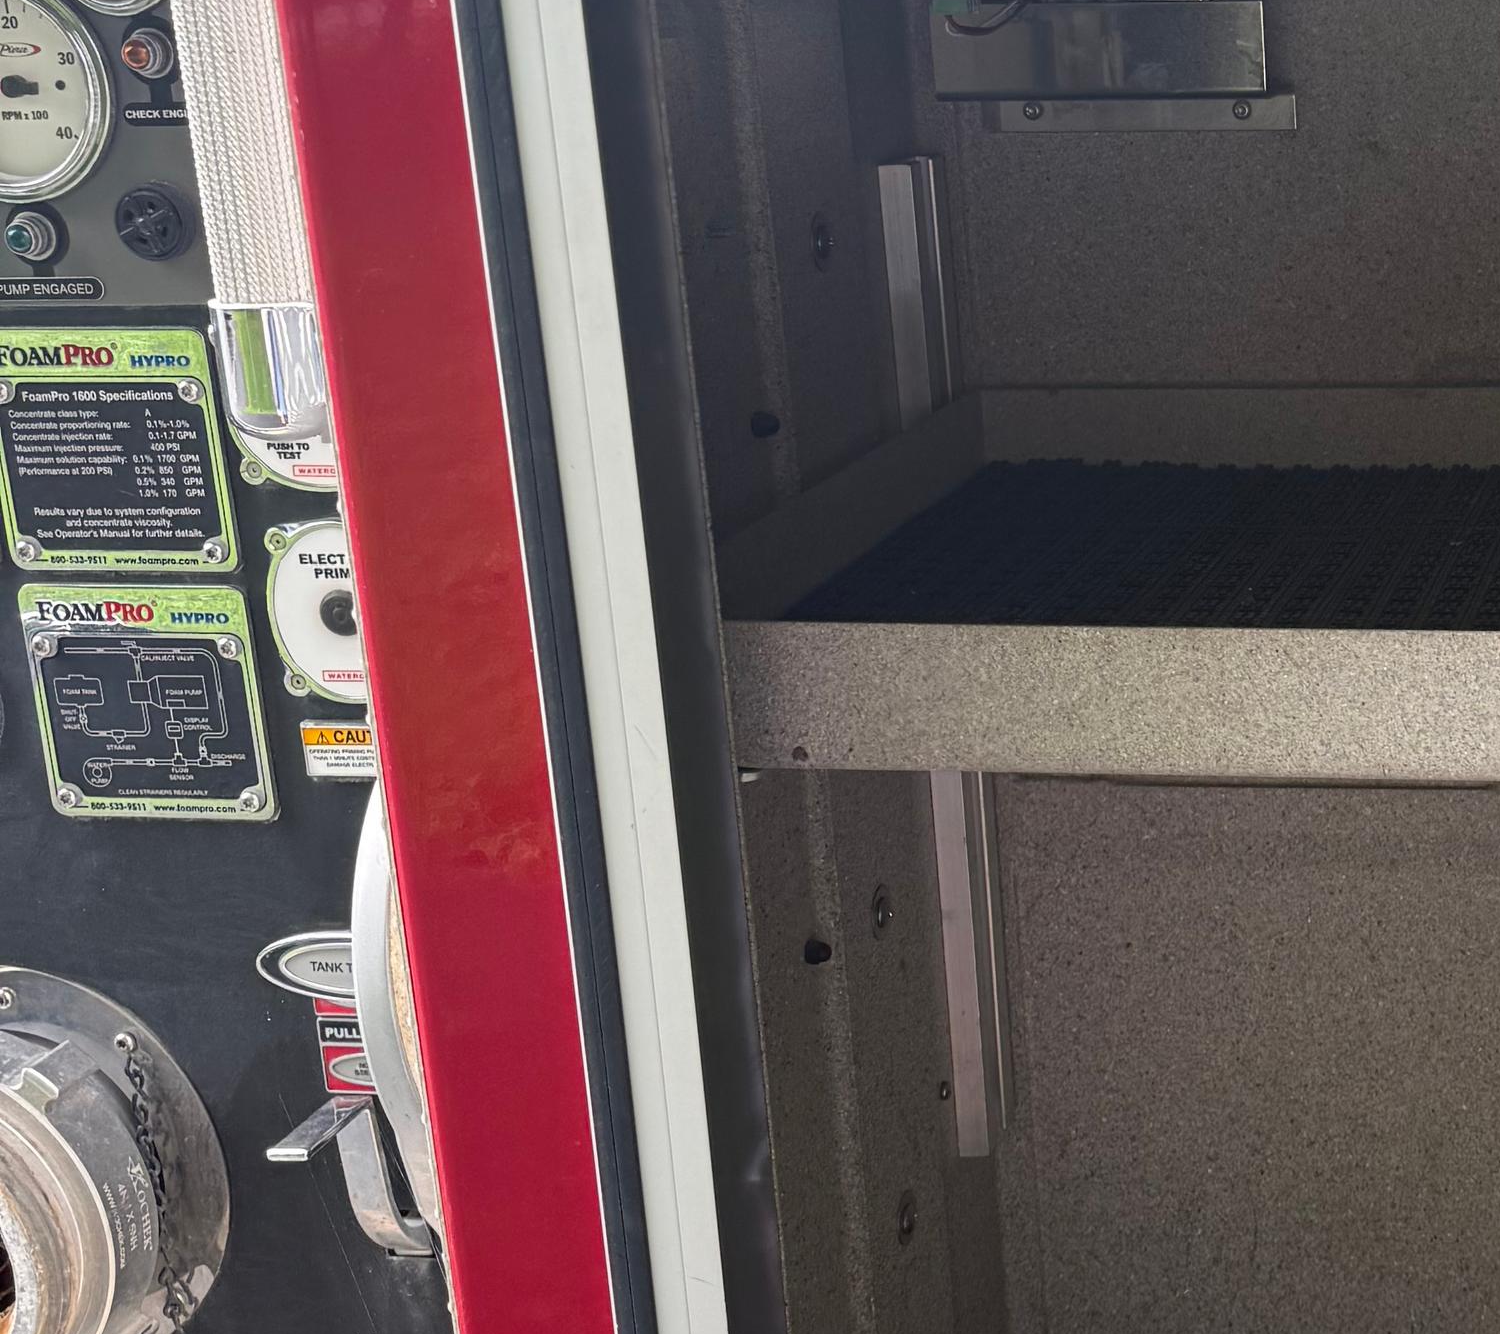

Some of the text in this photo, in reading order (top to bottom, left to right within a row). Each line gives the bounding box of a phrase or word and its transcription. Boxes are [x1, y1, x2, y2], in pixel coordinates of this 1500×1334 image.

[2, 16, 18, 29] 20
[57, 52, 75, 65] 30
[2, 110, 48, 120] RPM 100
[125, 109, 161, 119] CHECK
[56, 127, 73, 140] 40
[33, 283, 94, 295] ENGAGED
[130, 355, 190, 367] HYPRO
[22, 389, 173, 402] FoamPro 1600 Specifications
[8, 408, 152, 419] Concentrate class type: A
[10, 421, 58, 430] Concentrate
[59, 421, 112, 431] proportioning
[12, 431, 197, 442] Concentrate injection rate: 0.1-1.7 GPM
[14, 443, 180, 454] Maximum injection pressure: 400 PSI
[16, 454, 200, 465] Maximum solution capability: 0.1% 1700 GPM
[18, 466, 202, 477] (Performance at 200 PSI) 0.2% 850 GPM
[136, 477, 204, 486] 0.5% 340 GPM
[139, 488, 205, 497] 1.0% 170 GPM
[34, 506, 201, 517] Results vary due to system configuration
[66, 518, 173, 528] and concentrate viscosity.
[36, 528, 205, 539] See Operator's Manual for further details.
[50, 556, 199, 566] 800-533-9511 www.foampro.com
[299, 554, 345, 565] ELECT
[170, 612, 229, 624] HYPRO
[90, 803, 236, 814] 800-533-9511 www.foampro.com
[310, 962, 343, 973] TANK
[325, 1027, 361, 1038] PULL
